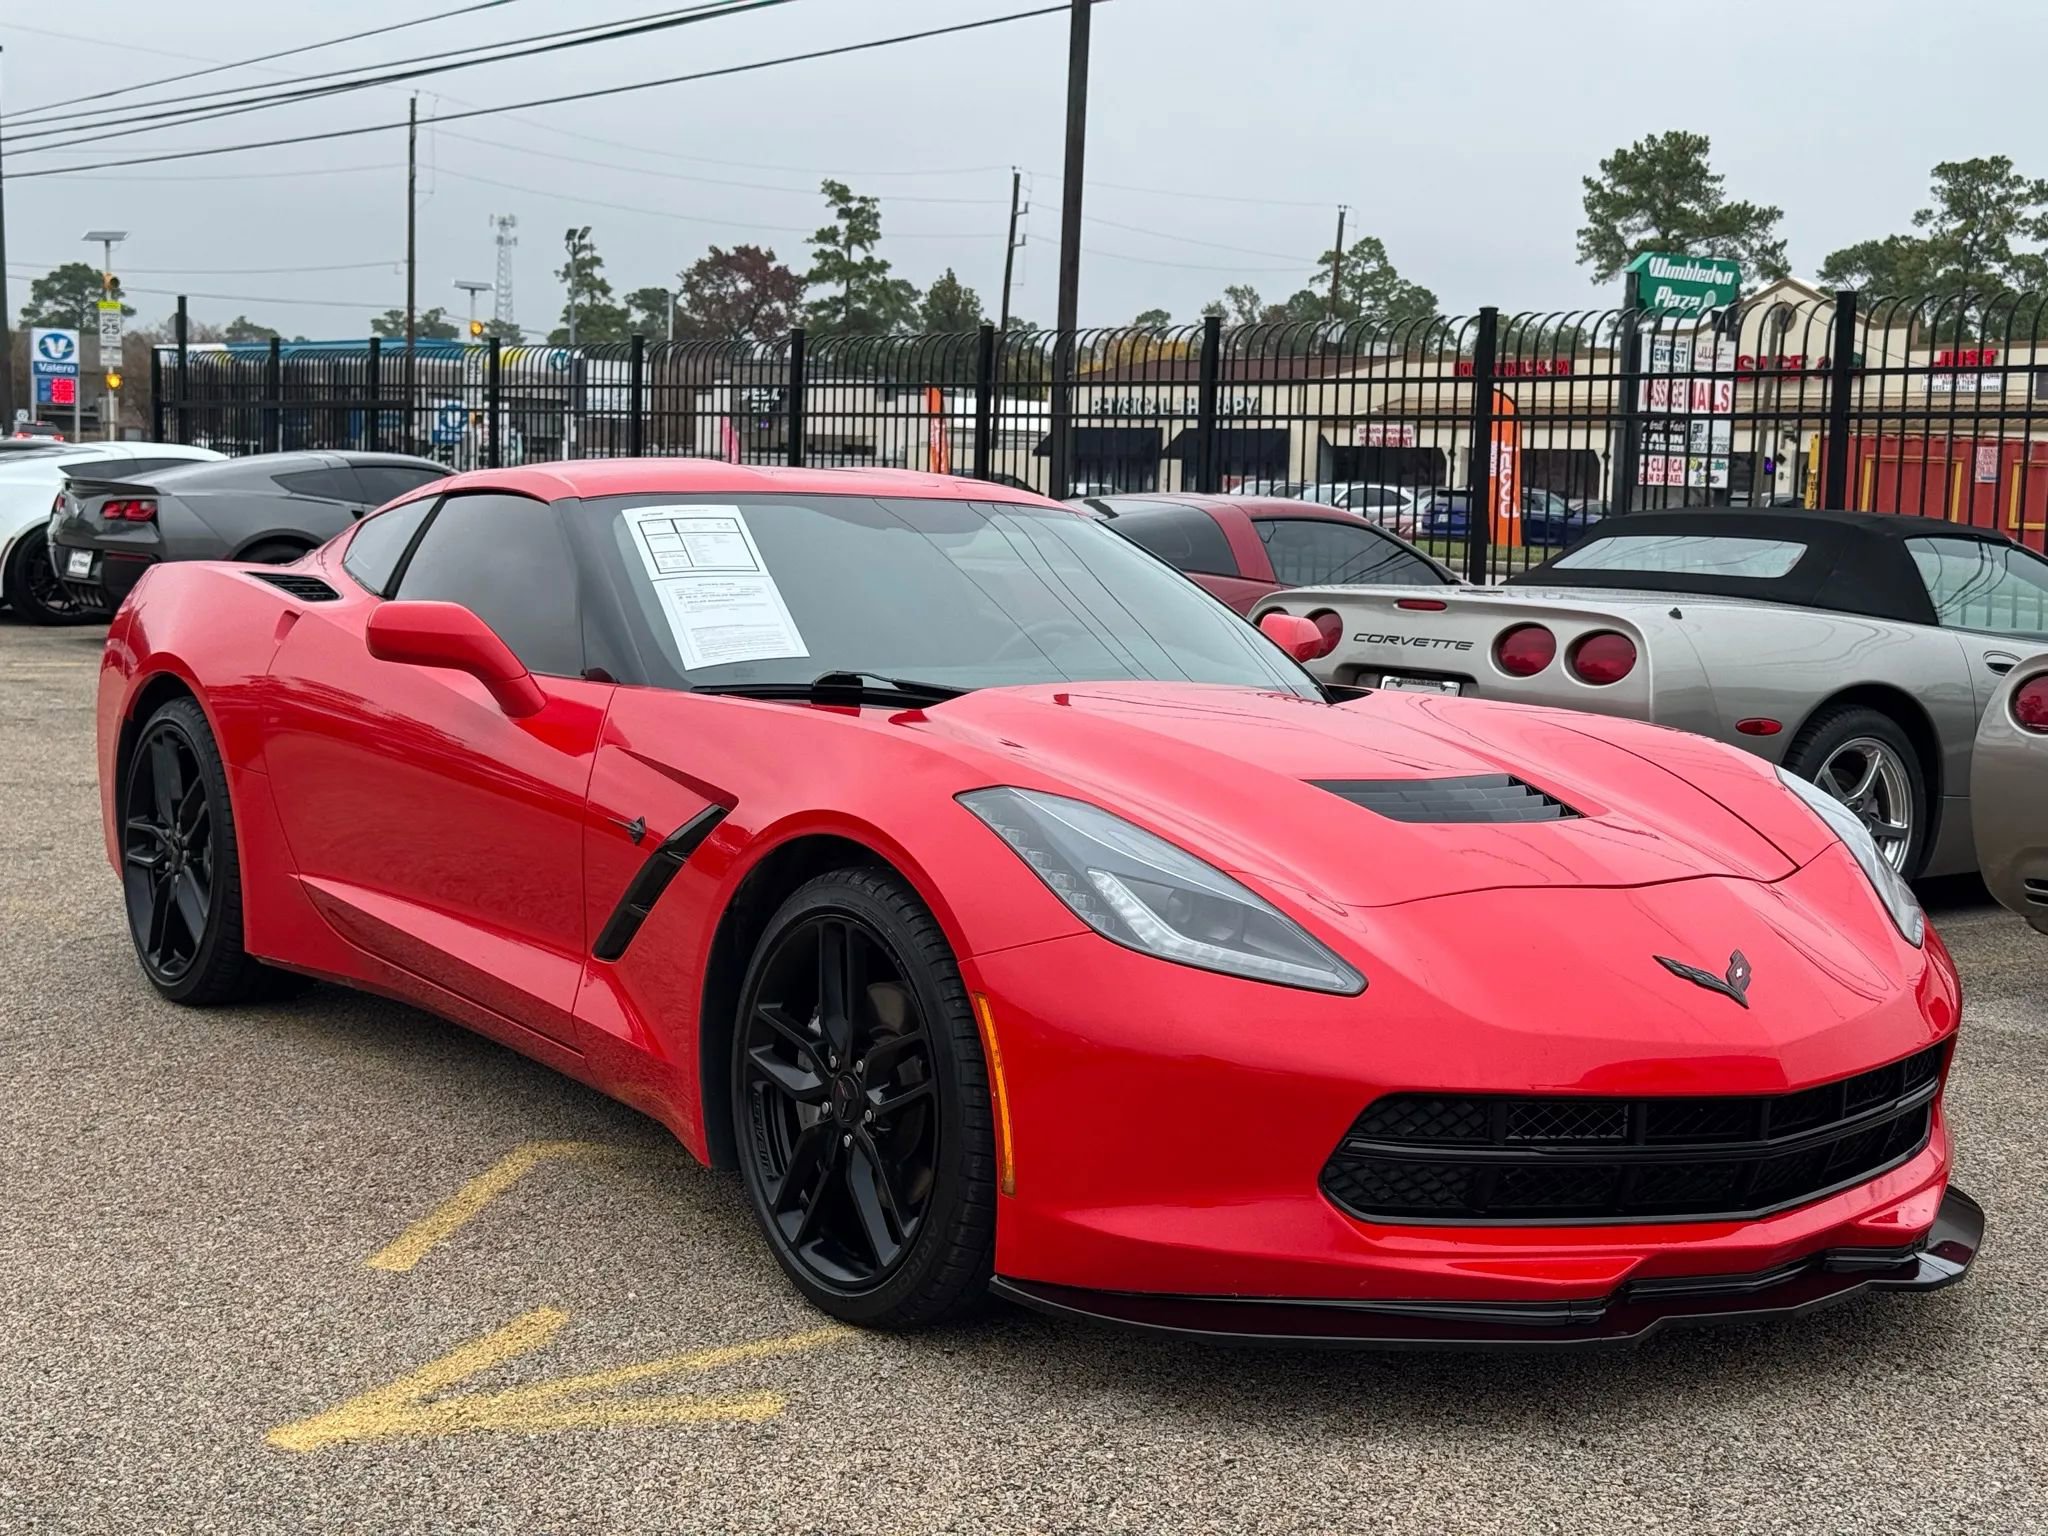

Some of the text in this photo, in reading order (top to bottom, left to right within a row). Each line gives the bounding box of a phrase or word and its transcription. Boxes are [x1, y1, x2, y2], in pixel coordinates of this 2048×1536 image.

[1648, 256, 1735, 286] Wimbledon
[1654, 285, 1702, 310] Plaza
[102, 323, 120, 335] 25
[1651, 348, 1687, 365] ENTST
[38, 363, 76, 374] Valero
[1642, 433, 1684, 445] SALN
[1651, 457, 1683, 473] CLIICA
[1639, 473, 1654, 483] SN
[1656, 473, 1682, 484] RAAEL
[1353, 633, 1475, 651] CORVETTE
